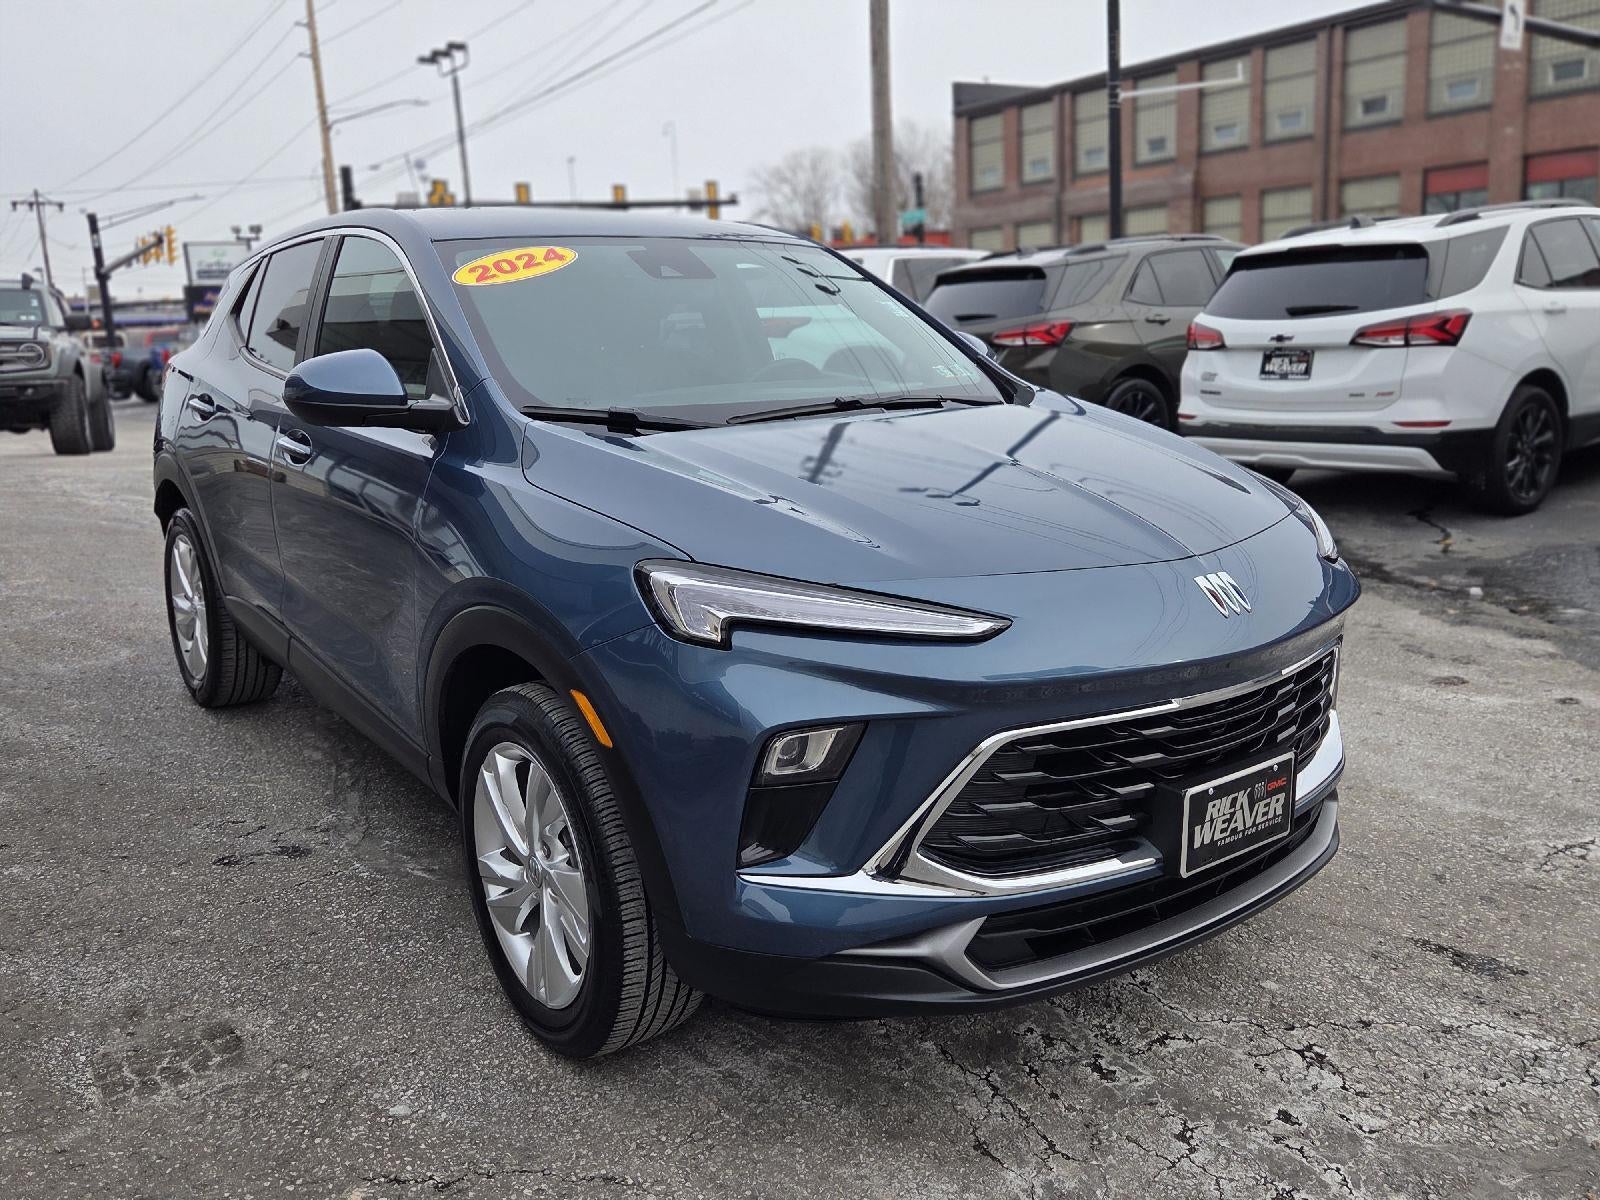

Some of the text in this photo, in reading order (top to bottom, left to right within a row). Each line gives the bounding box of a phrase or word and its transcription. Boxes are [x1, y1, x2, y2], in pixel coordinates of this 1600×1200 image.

[468, 247, 567, 283] 2024
[1267, 777, 1287, 791] GMC
[1194, 792, 1285, 849] WEAVER
[1205, 787, 1251, 822] RICK
[1217, 816, 1282, 847] FAMOUS FOR SERVICE
